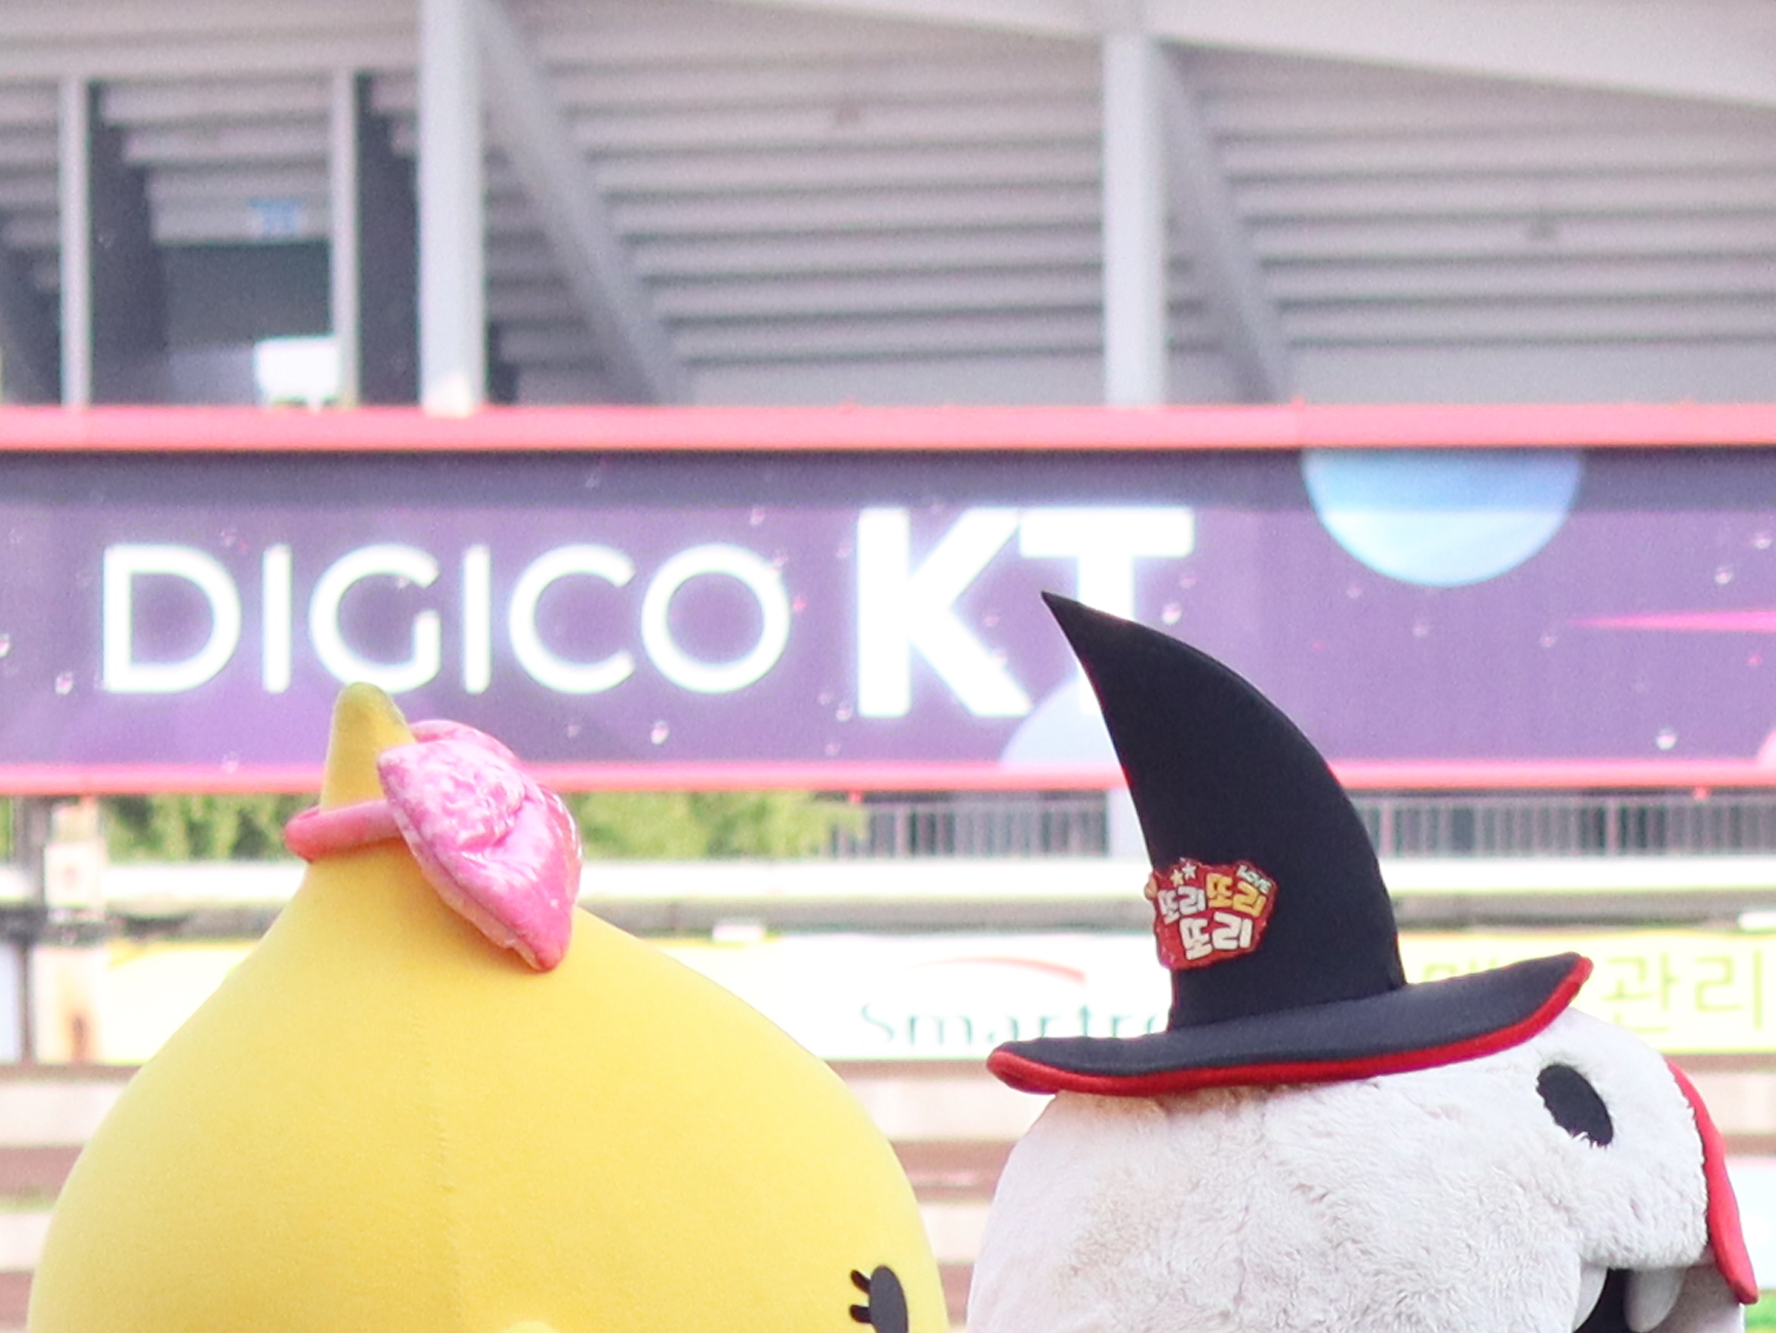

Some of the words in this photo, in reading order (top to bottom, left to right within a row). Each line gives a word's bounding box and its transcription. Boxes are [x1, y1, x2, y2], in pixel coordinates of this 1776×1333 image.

[102, 542, 790, 695] DIGICO
[854, 505, 1196, 718] KT
[1602, 949, 1764, 1033] 관리
